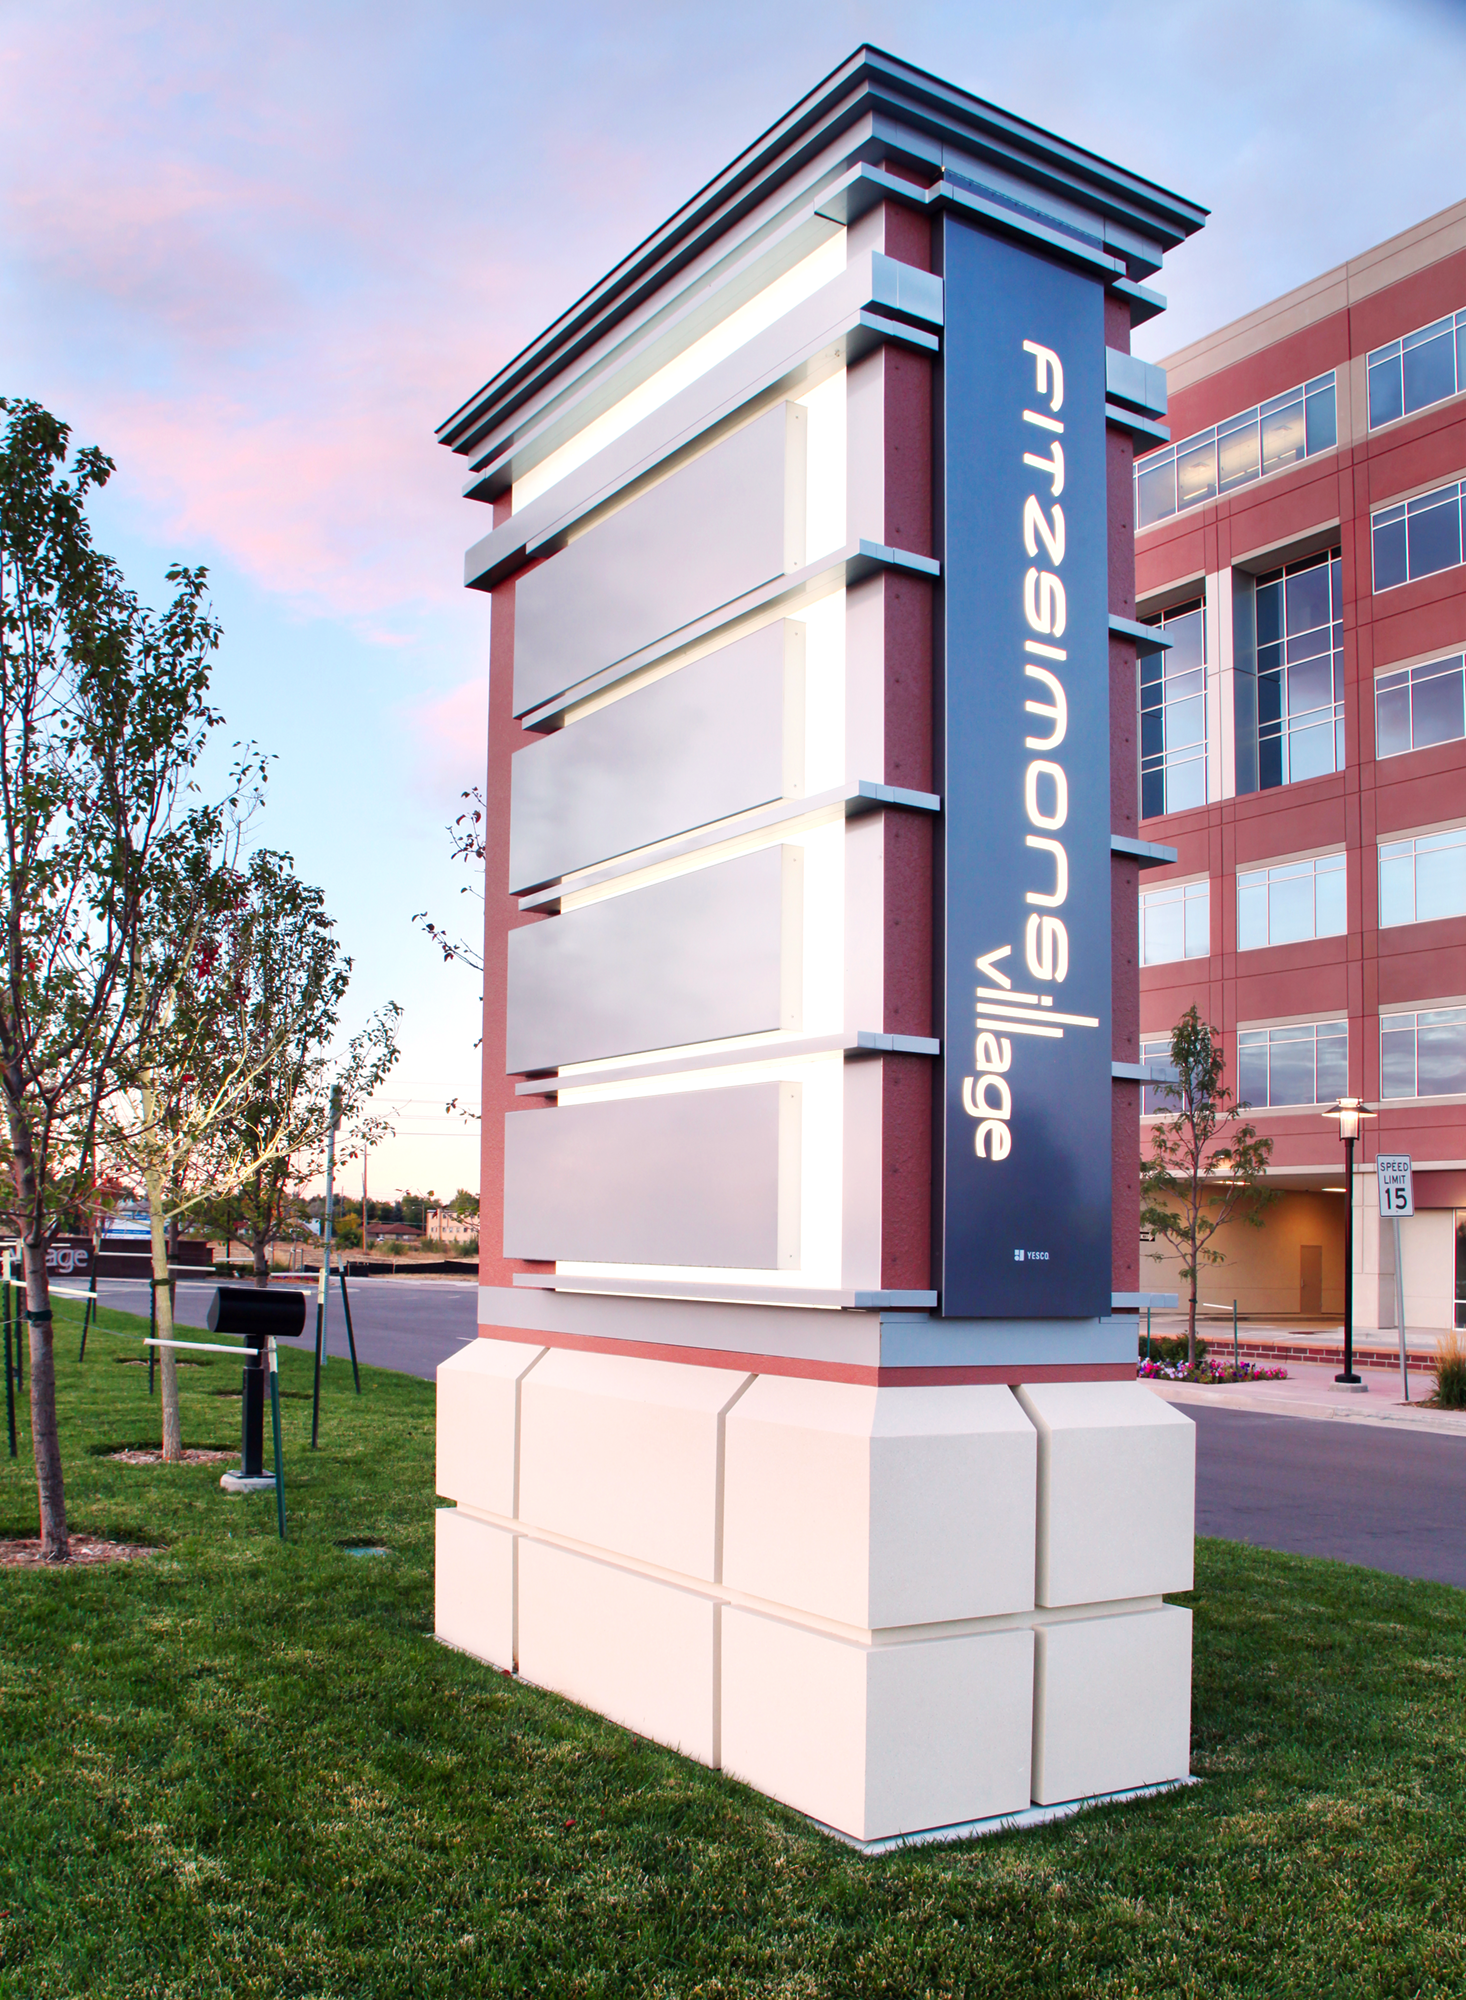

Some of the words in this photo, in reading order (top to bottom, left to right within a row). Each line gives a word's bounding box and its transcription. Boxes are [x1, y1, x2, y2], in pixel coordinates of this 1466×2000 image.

[963, 944, 1100, 1162] village
[1380, 1162, 1409, 1172] SPEED
[1383, 1175, 1406, 1184] LIMIT
[1385, 1187, 1407, 1210] 15
[1027, 1251, 1050, 1260] YESCO
